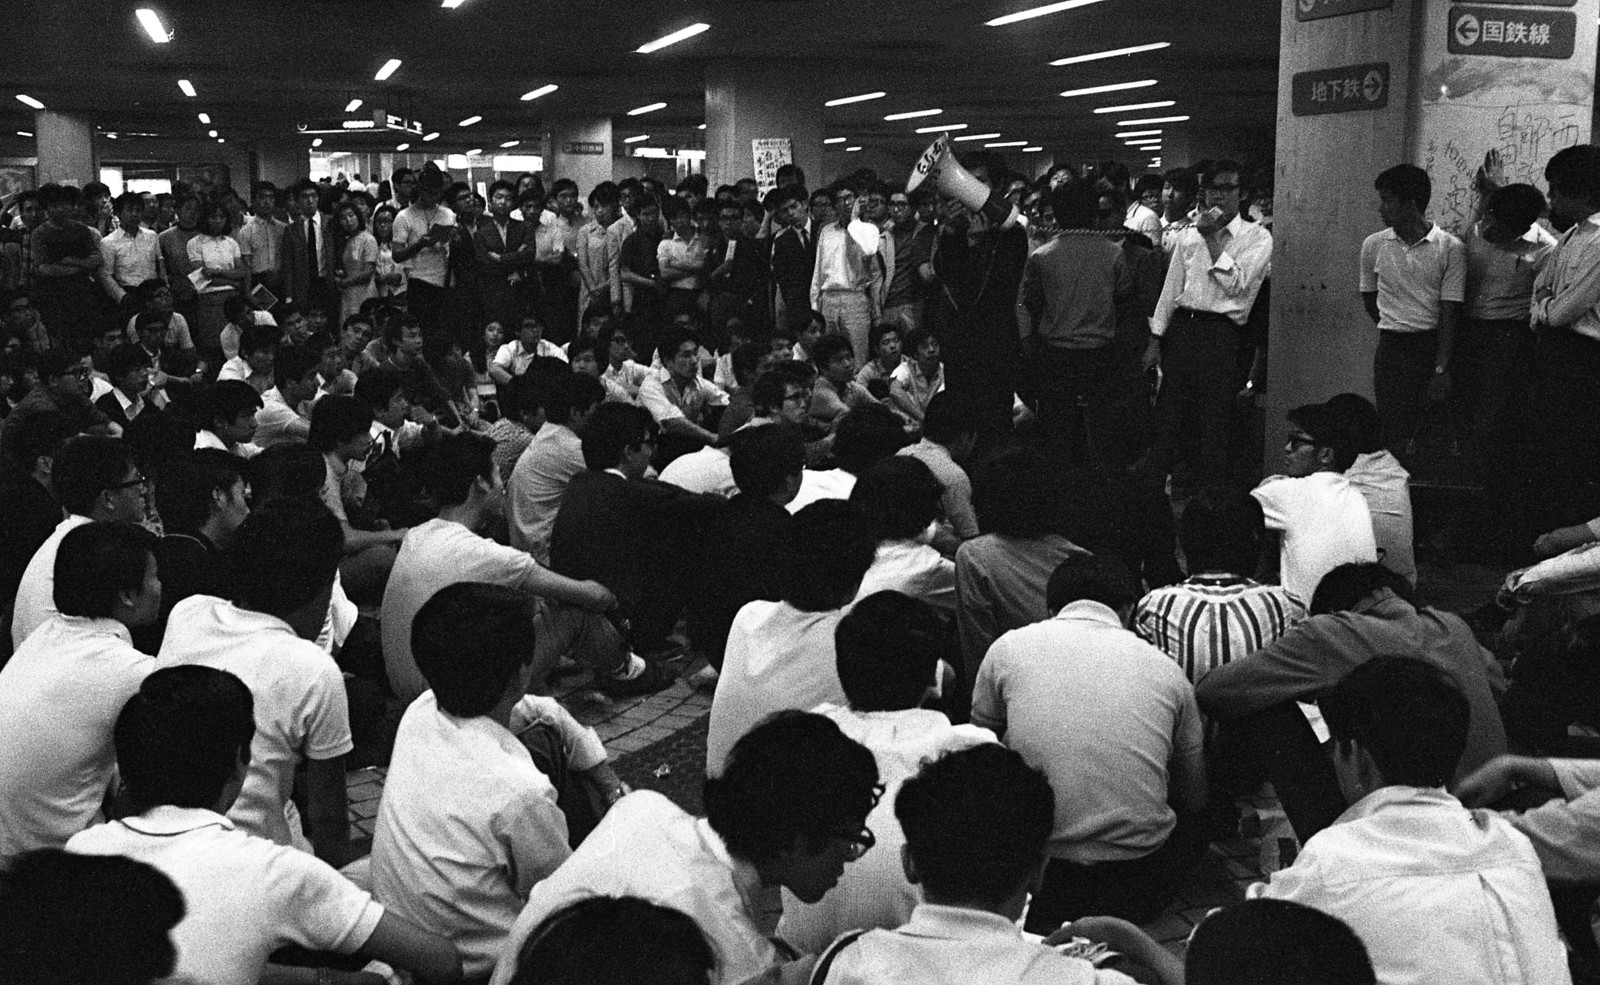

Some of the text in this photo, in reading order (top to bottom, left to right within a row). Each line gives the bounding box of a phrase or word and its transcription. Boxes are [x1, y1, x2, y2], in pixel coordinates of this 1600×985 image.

[1482, 20, 1550, 45] 国鉄線
[1311, 77, 1361, 101] 地下鉄
